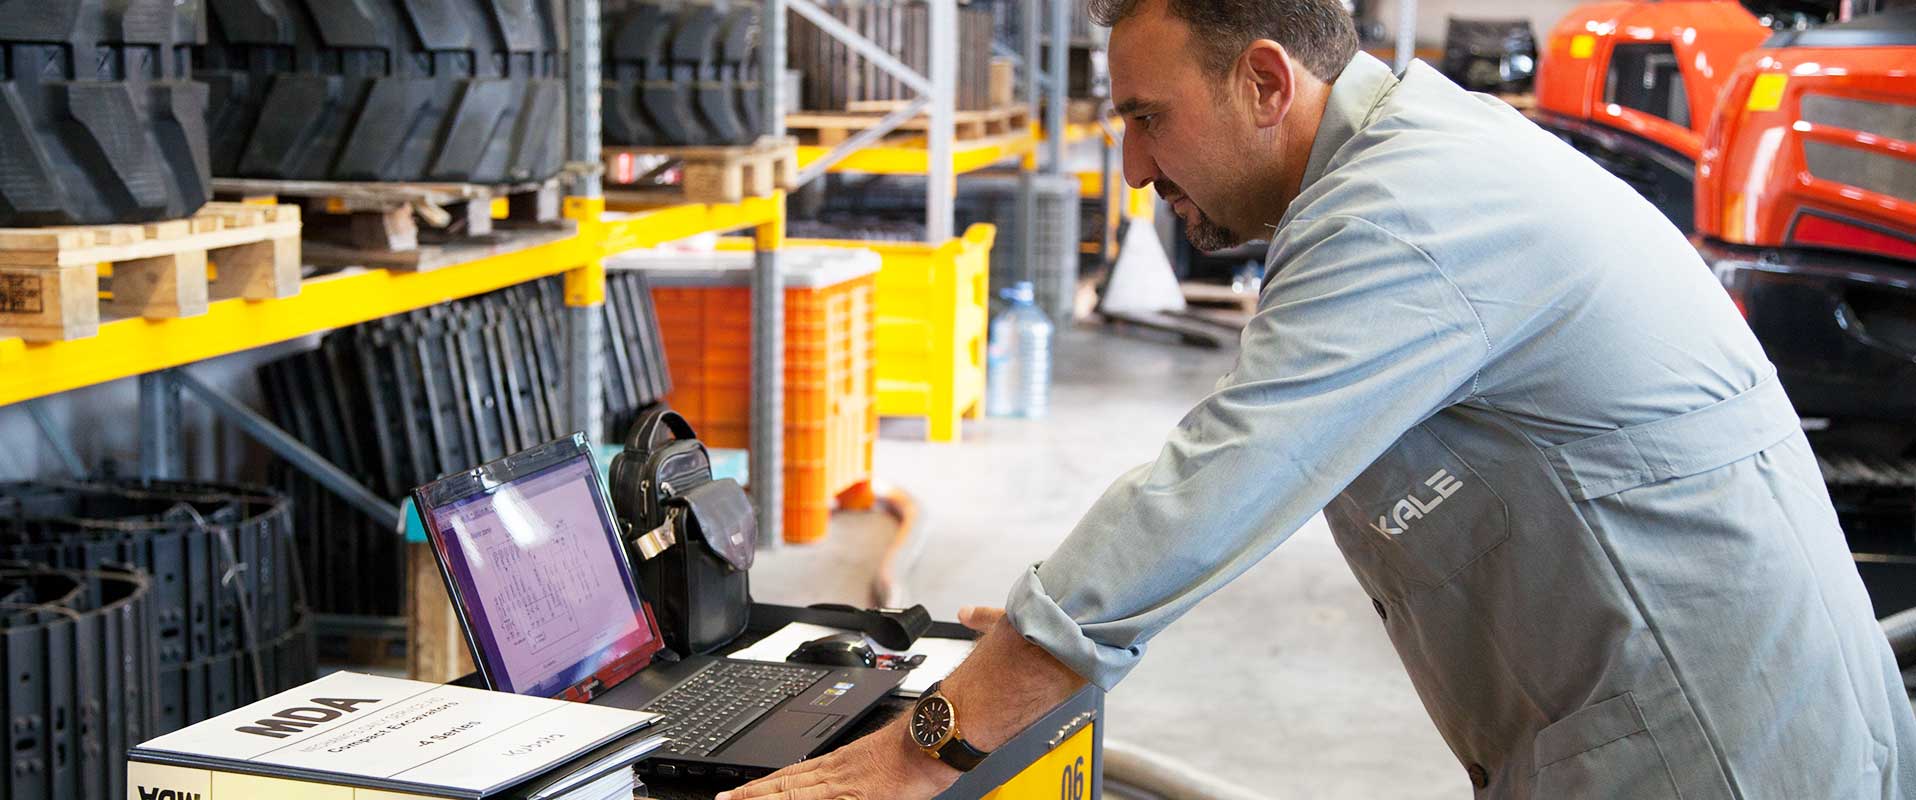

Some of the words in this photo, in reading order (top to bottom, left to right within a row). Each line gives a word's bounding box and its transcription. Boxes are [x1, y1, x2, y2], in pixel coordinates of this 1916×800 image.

[1370, 468, 1464, 540] KALE
[234, 697, 383, 739] MDA
[327, 728, 391, 753] Compact
[387, 701, 460, 731] Excavators
[434, 720, 482, 741] Series
[501, 733, 566, 757] Kubota
